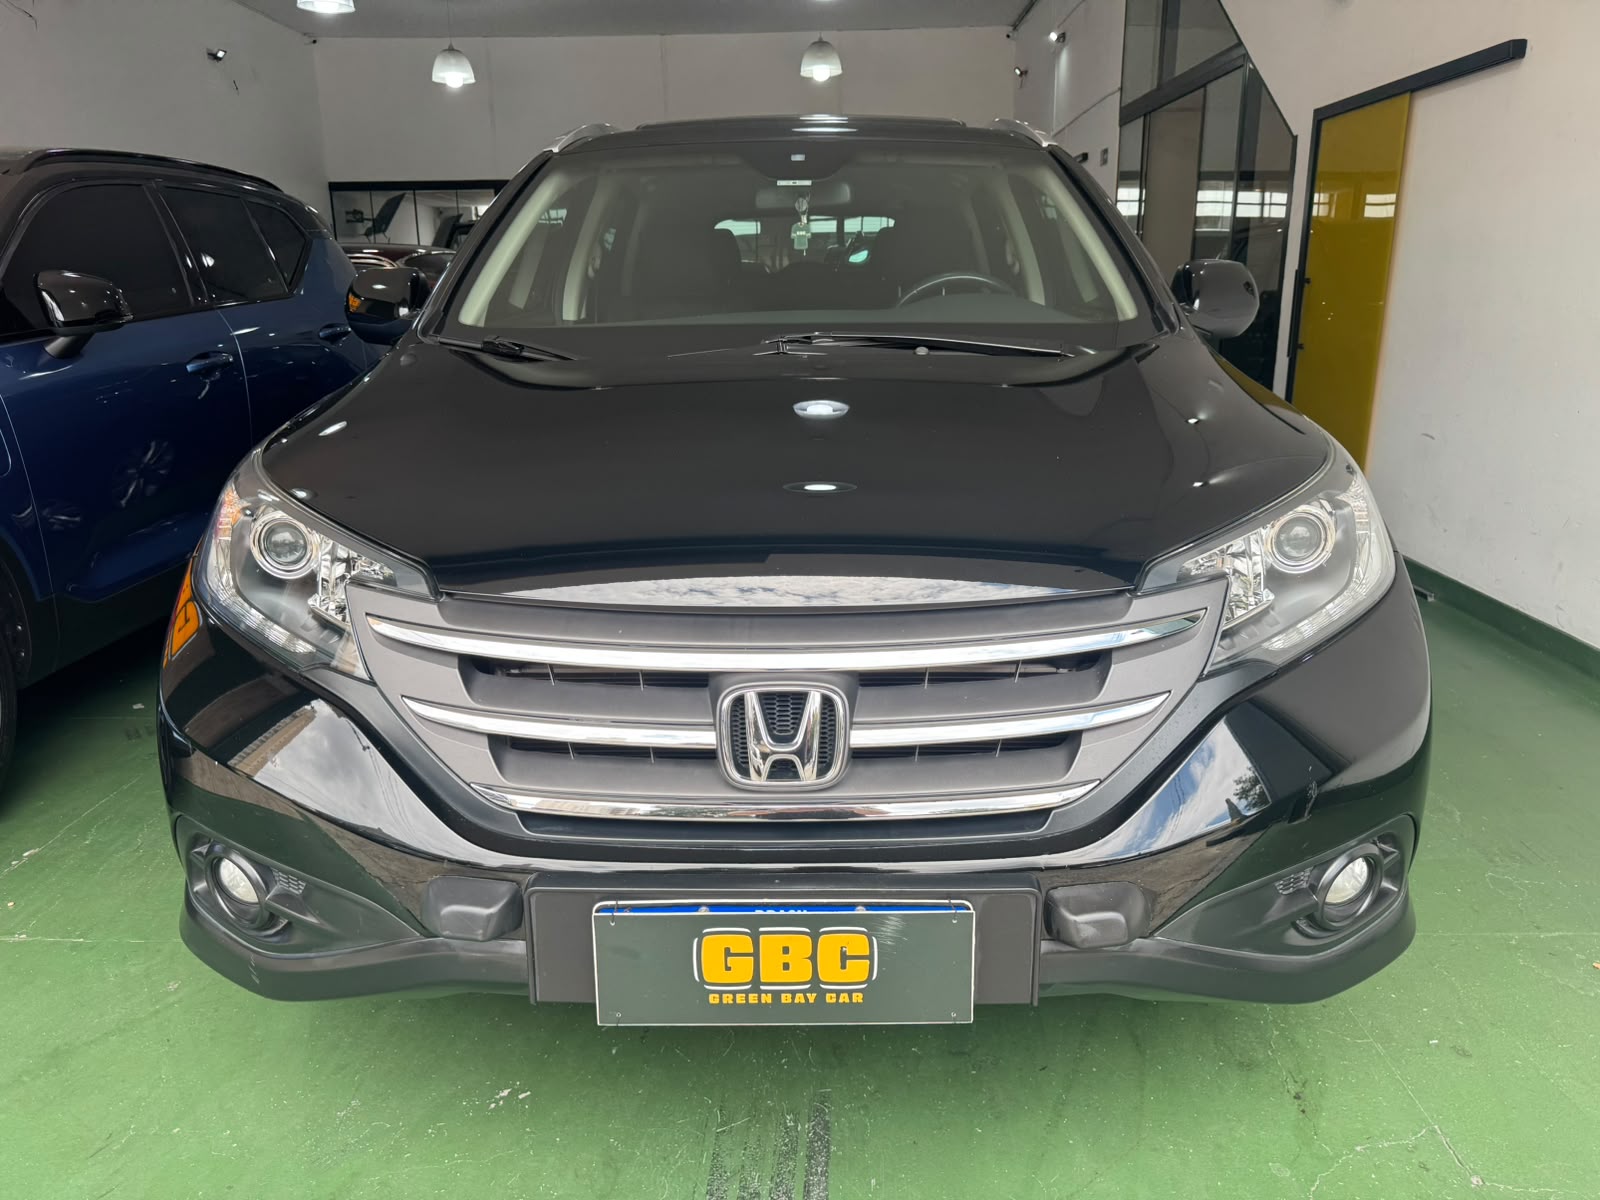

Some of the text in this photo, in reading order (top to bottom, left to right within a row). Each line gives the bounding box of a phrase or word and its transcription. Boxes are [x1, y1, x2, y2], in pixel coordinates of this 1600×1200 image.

[701, 933, 870, 984] GBC
[708, 992, 864, 1004] GREEN BAY CAR
